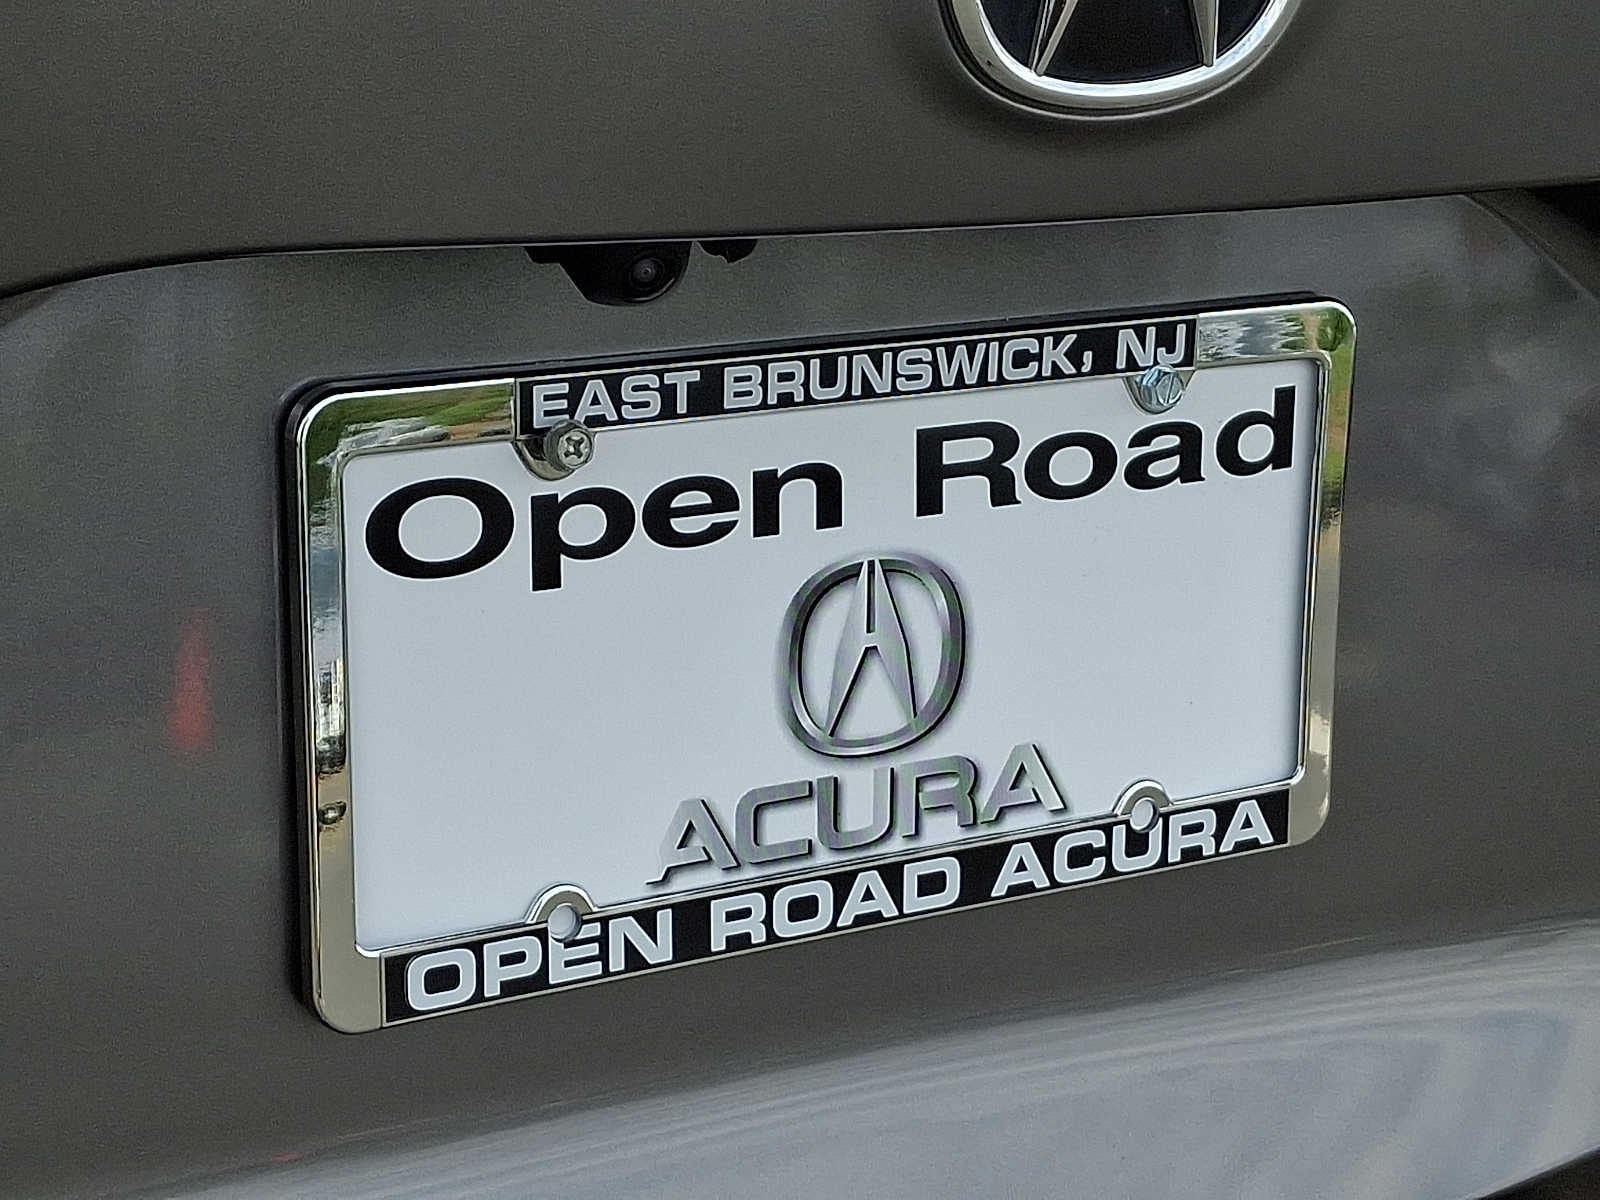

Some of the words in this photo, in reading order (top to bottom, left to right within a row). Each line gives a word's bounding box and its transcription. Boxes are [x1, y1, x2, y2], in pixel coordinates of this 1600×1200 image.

[532, 369, 700, 429] EAST
[723, 333, 1093, 410] BRUNSWICK,
[1115, 323, 1186, 370] NJ
[364, 459, 845, 592] Open
[914, 384, 1297, 518] Road
[646, 743, 1067, 885] ACURA
[406, 908, 674, 1012] OPEN
[710, 855, 961, 953] ROAD
[990, 798, 1275, 898] ACURA
